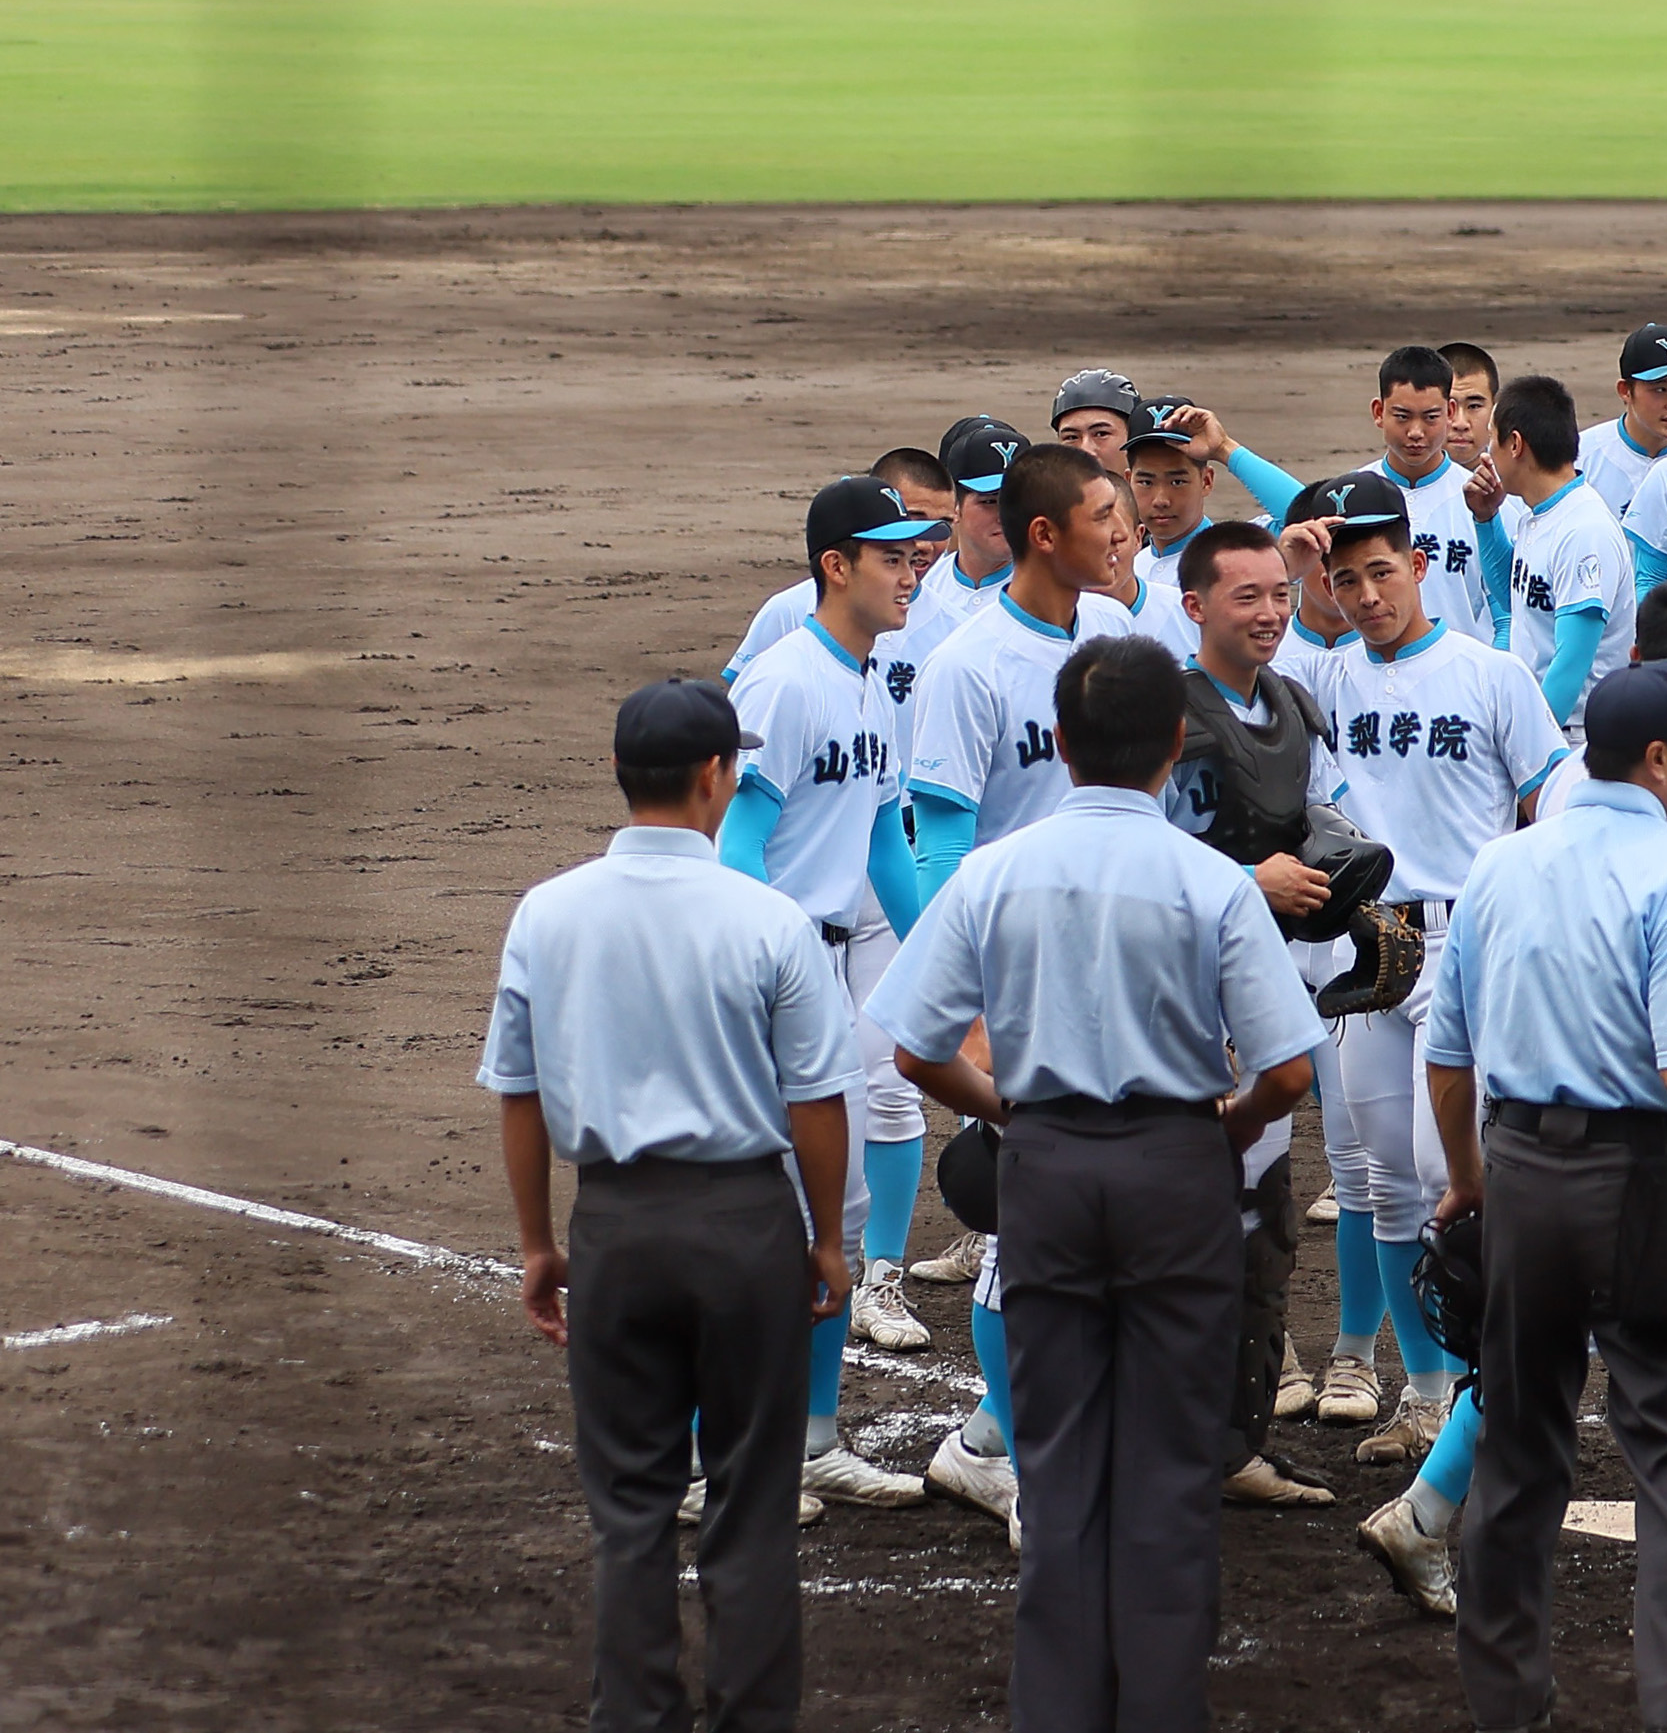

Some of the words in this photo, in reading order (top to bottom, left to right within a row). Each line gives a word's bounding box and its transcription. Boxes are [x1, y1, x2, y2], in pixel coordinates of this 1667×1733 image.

[1146, 405, 1174, 429] Y
[990, 441, 1018, 469] Y
[880, 487, 908, 517] Y
[1326, 483, 1356, 515] Y
